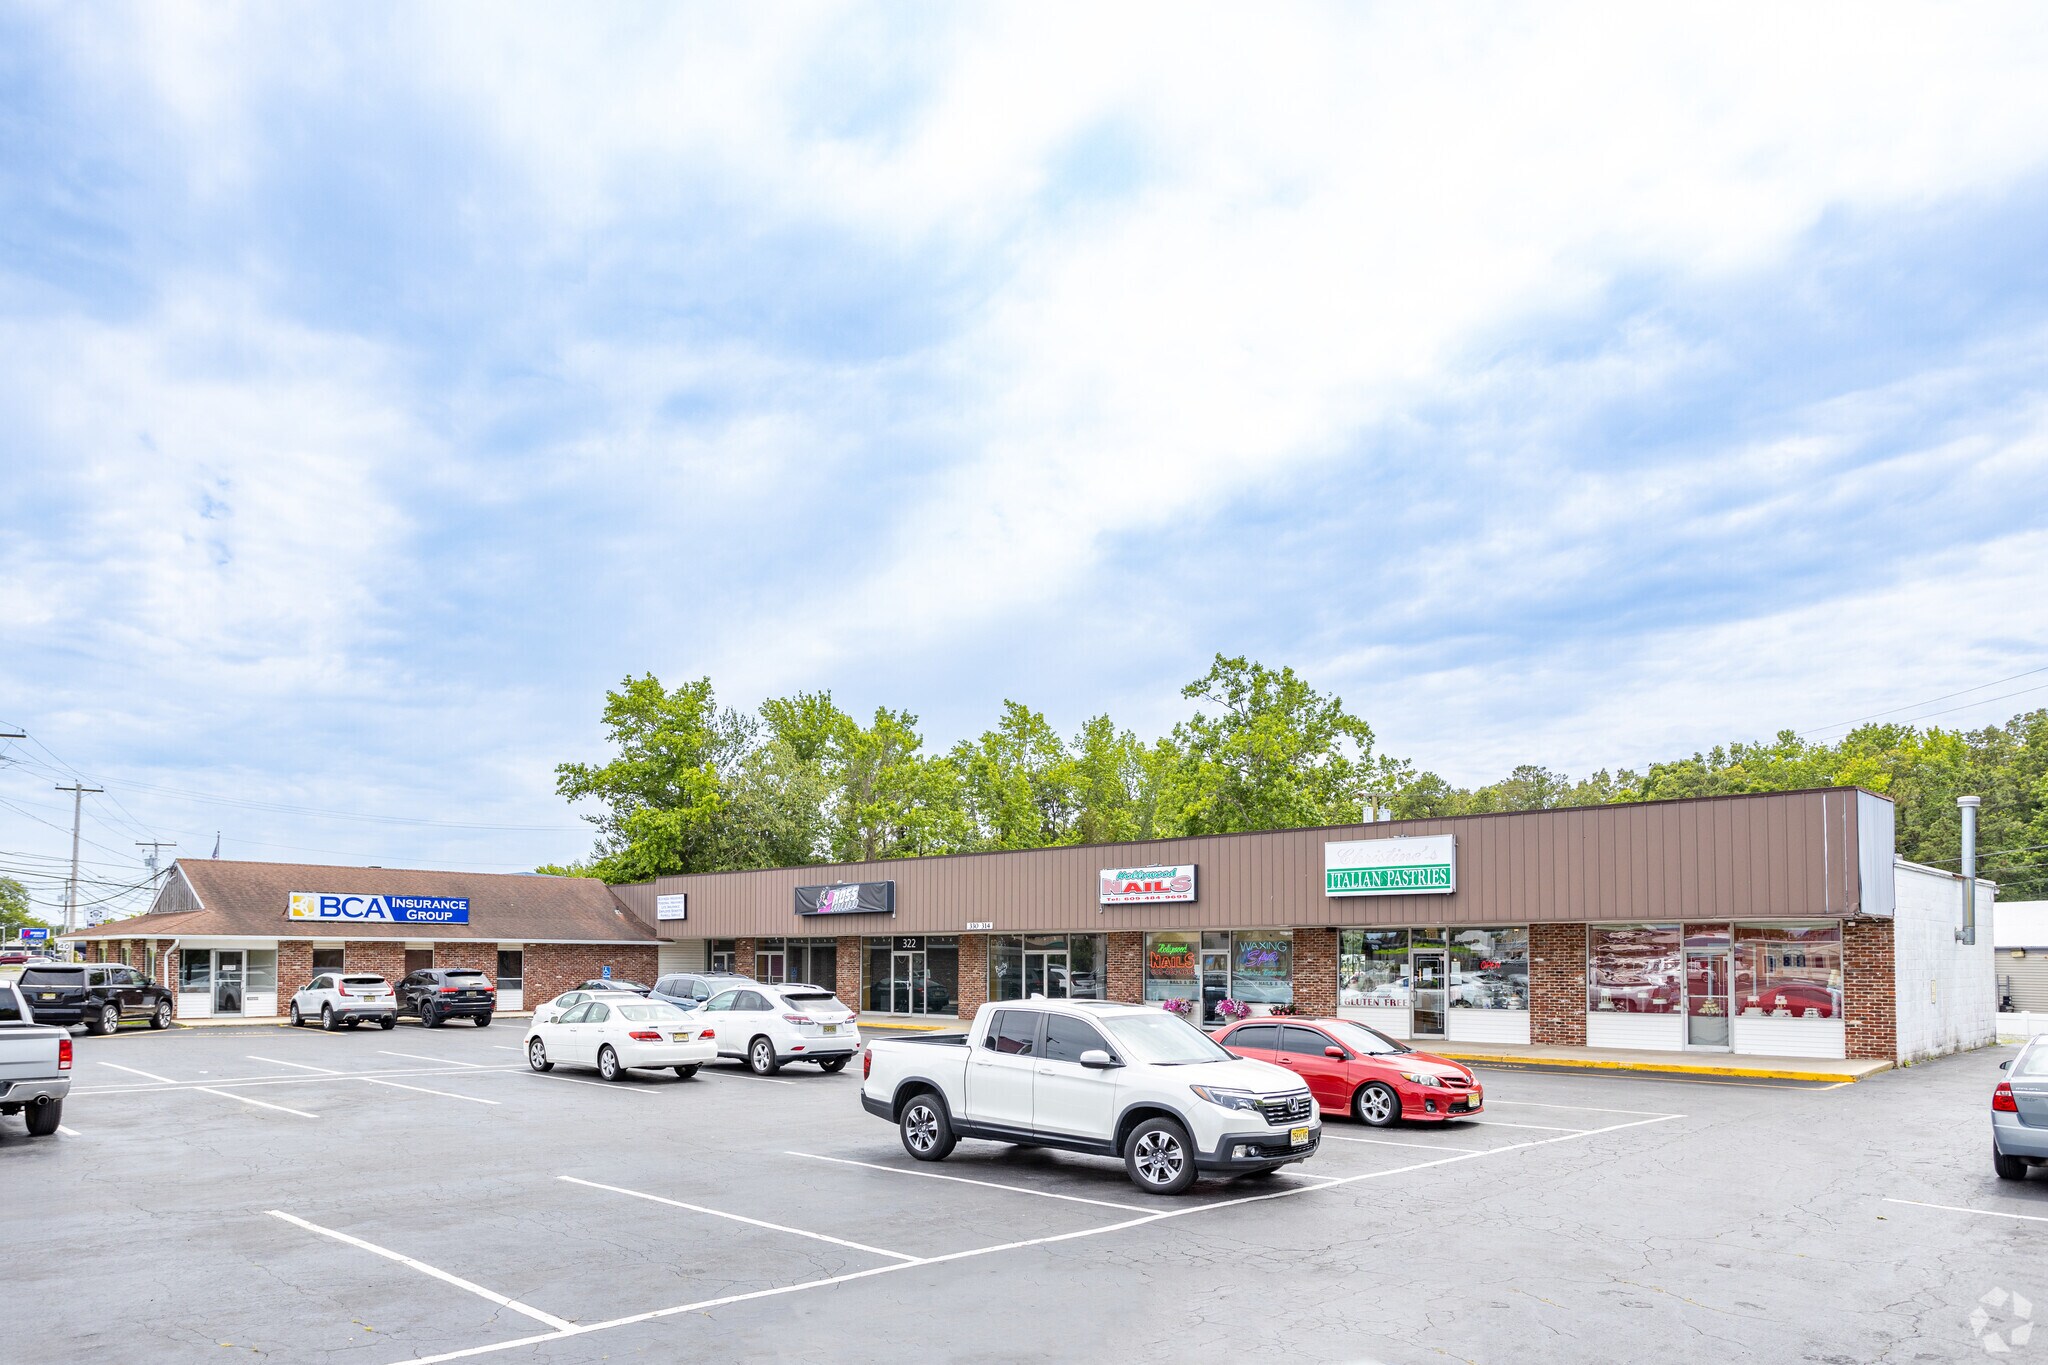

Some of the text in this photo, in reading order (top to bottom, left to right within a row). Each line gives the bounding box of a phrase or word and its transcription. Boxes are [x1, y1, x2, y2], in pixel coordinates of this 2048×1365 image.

[1116, 868, 1177, 881] Hollywood
[1330, 868, 1447, 889] ITALIAN PASTRIES
[1102, 875, 1192, 895] NAILS
[319, 896, 387, 919] BCA
[391, 897, 467, 910] INSURANCE
[406, 909, 453, 921] GROUP
[902, 938, 917, 949] 322
[1239, 940, 1288, 953] WAXING
[1150, 951, 1196, 969] NAILS
[1244, 949, 1279, 967] Spa
[1479, 960, 1501, 971] OPEN
[1344, 998, 1408, 1007] GLUTEN FREE
